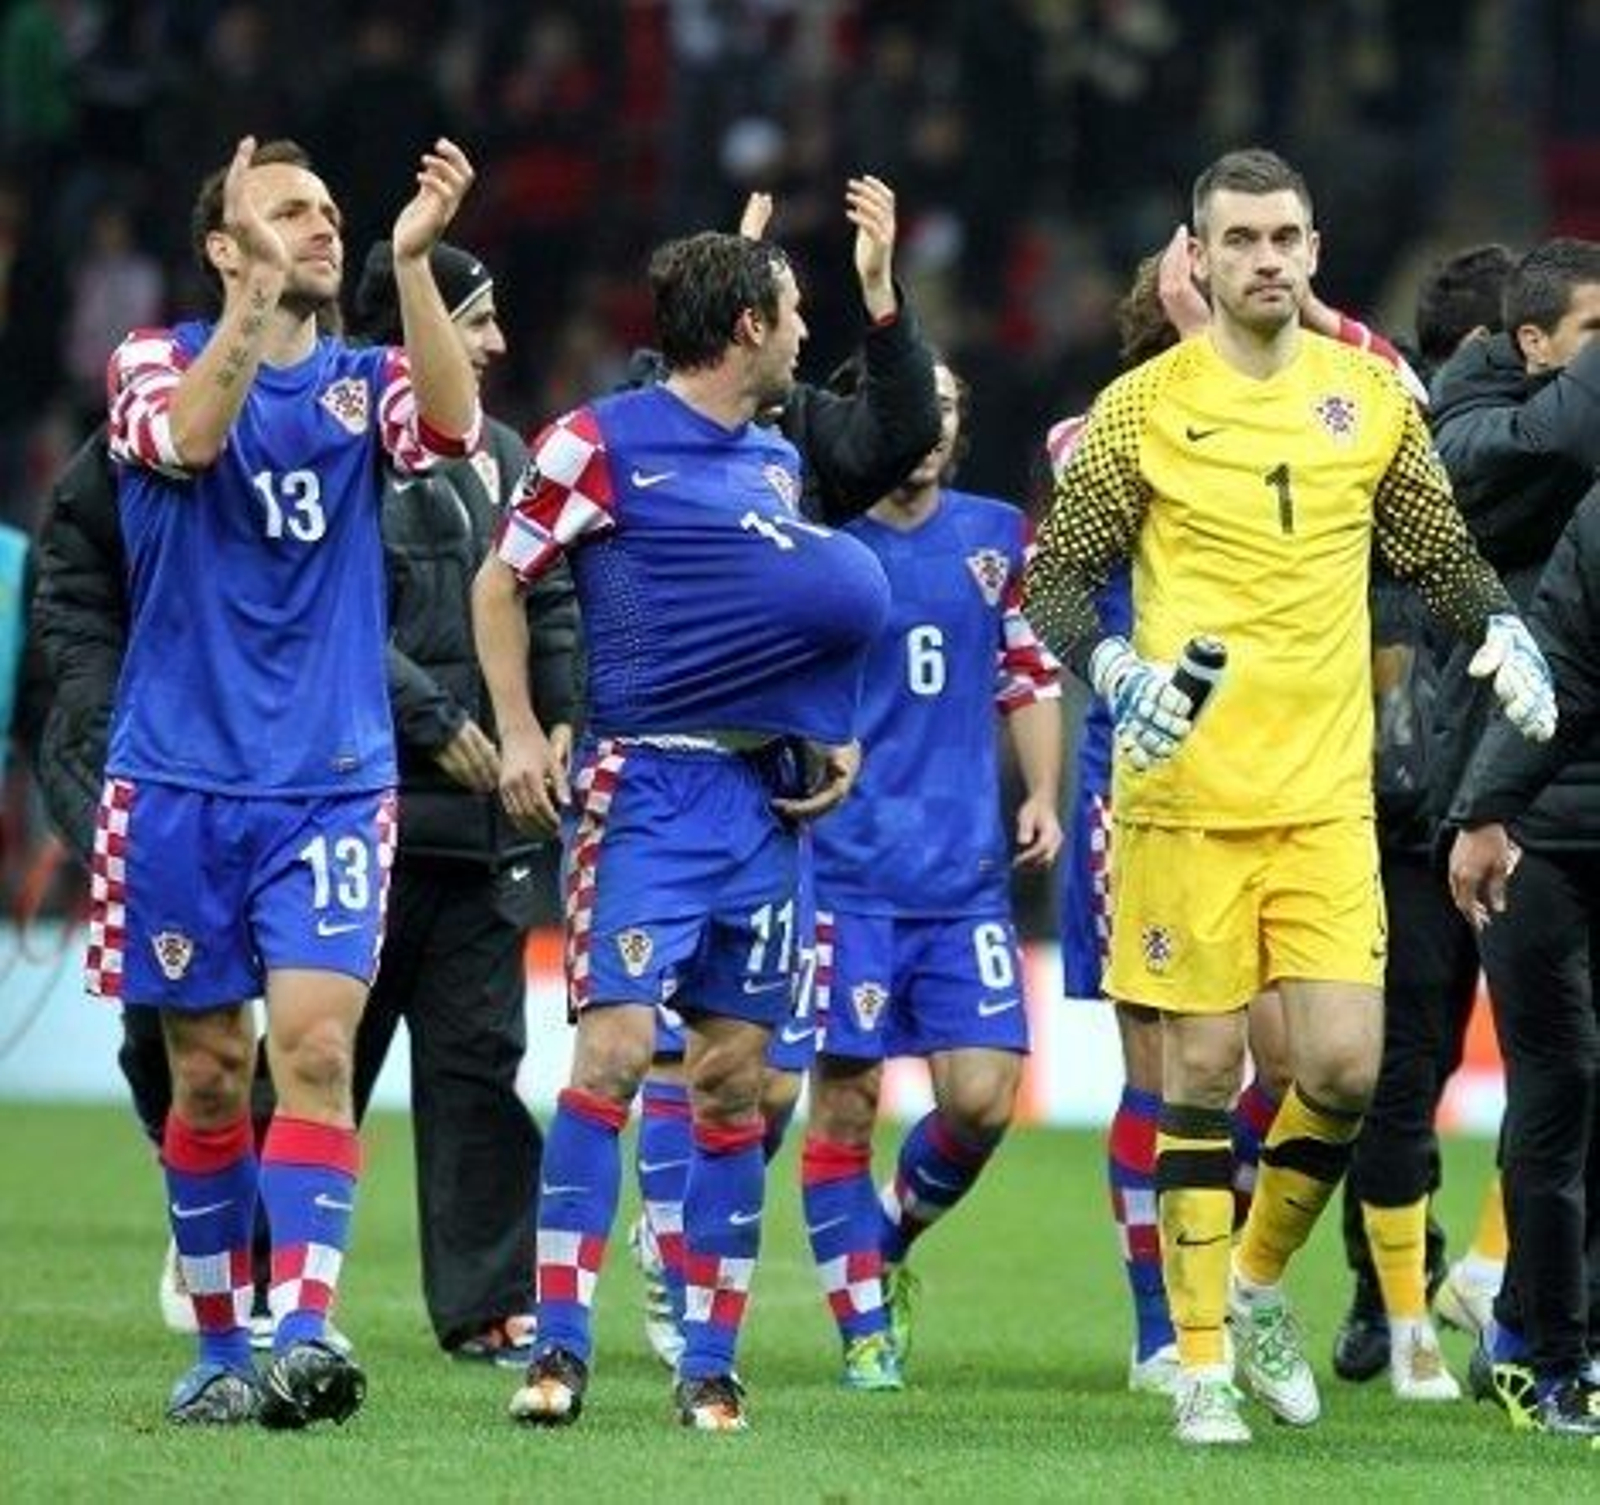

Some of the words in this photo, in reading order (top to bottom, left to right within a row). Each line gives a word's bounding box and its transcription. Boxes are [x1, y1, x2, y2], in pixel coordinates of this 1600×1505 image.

[253, 471, 326, 541] 13
[1265, 463, 1293, 533] 1
[908, 625, 945, 694] 6
[300, 837, 368, 909] 13
[747, 899, 793, 973] 11
[974, 923, 1014, 989] 6
